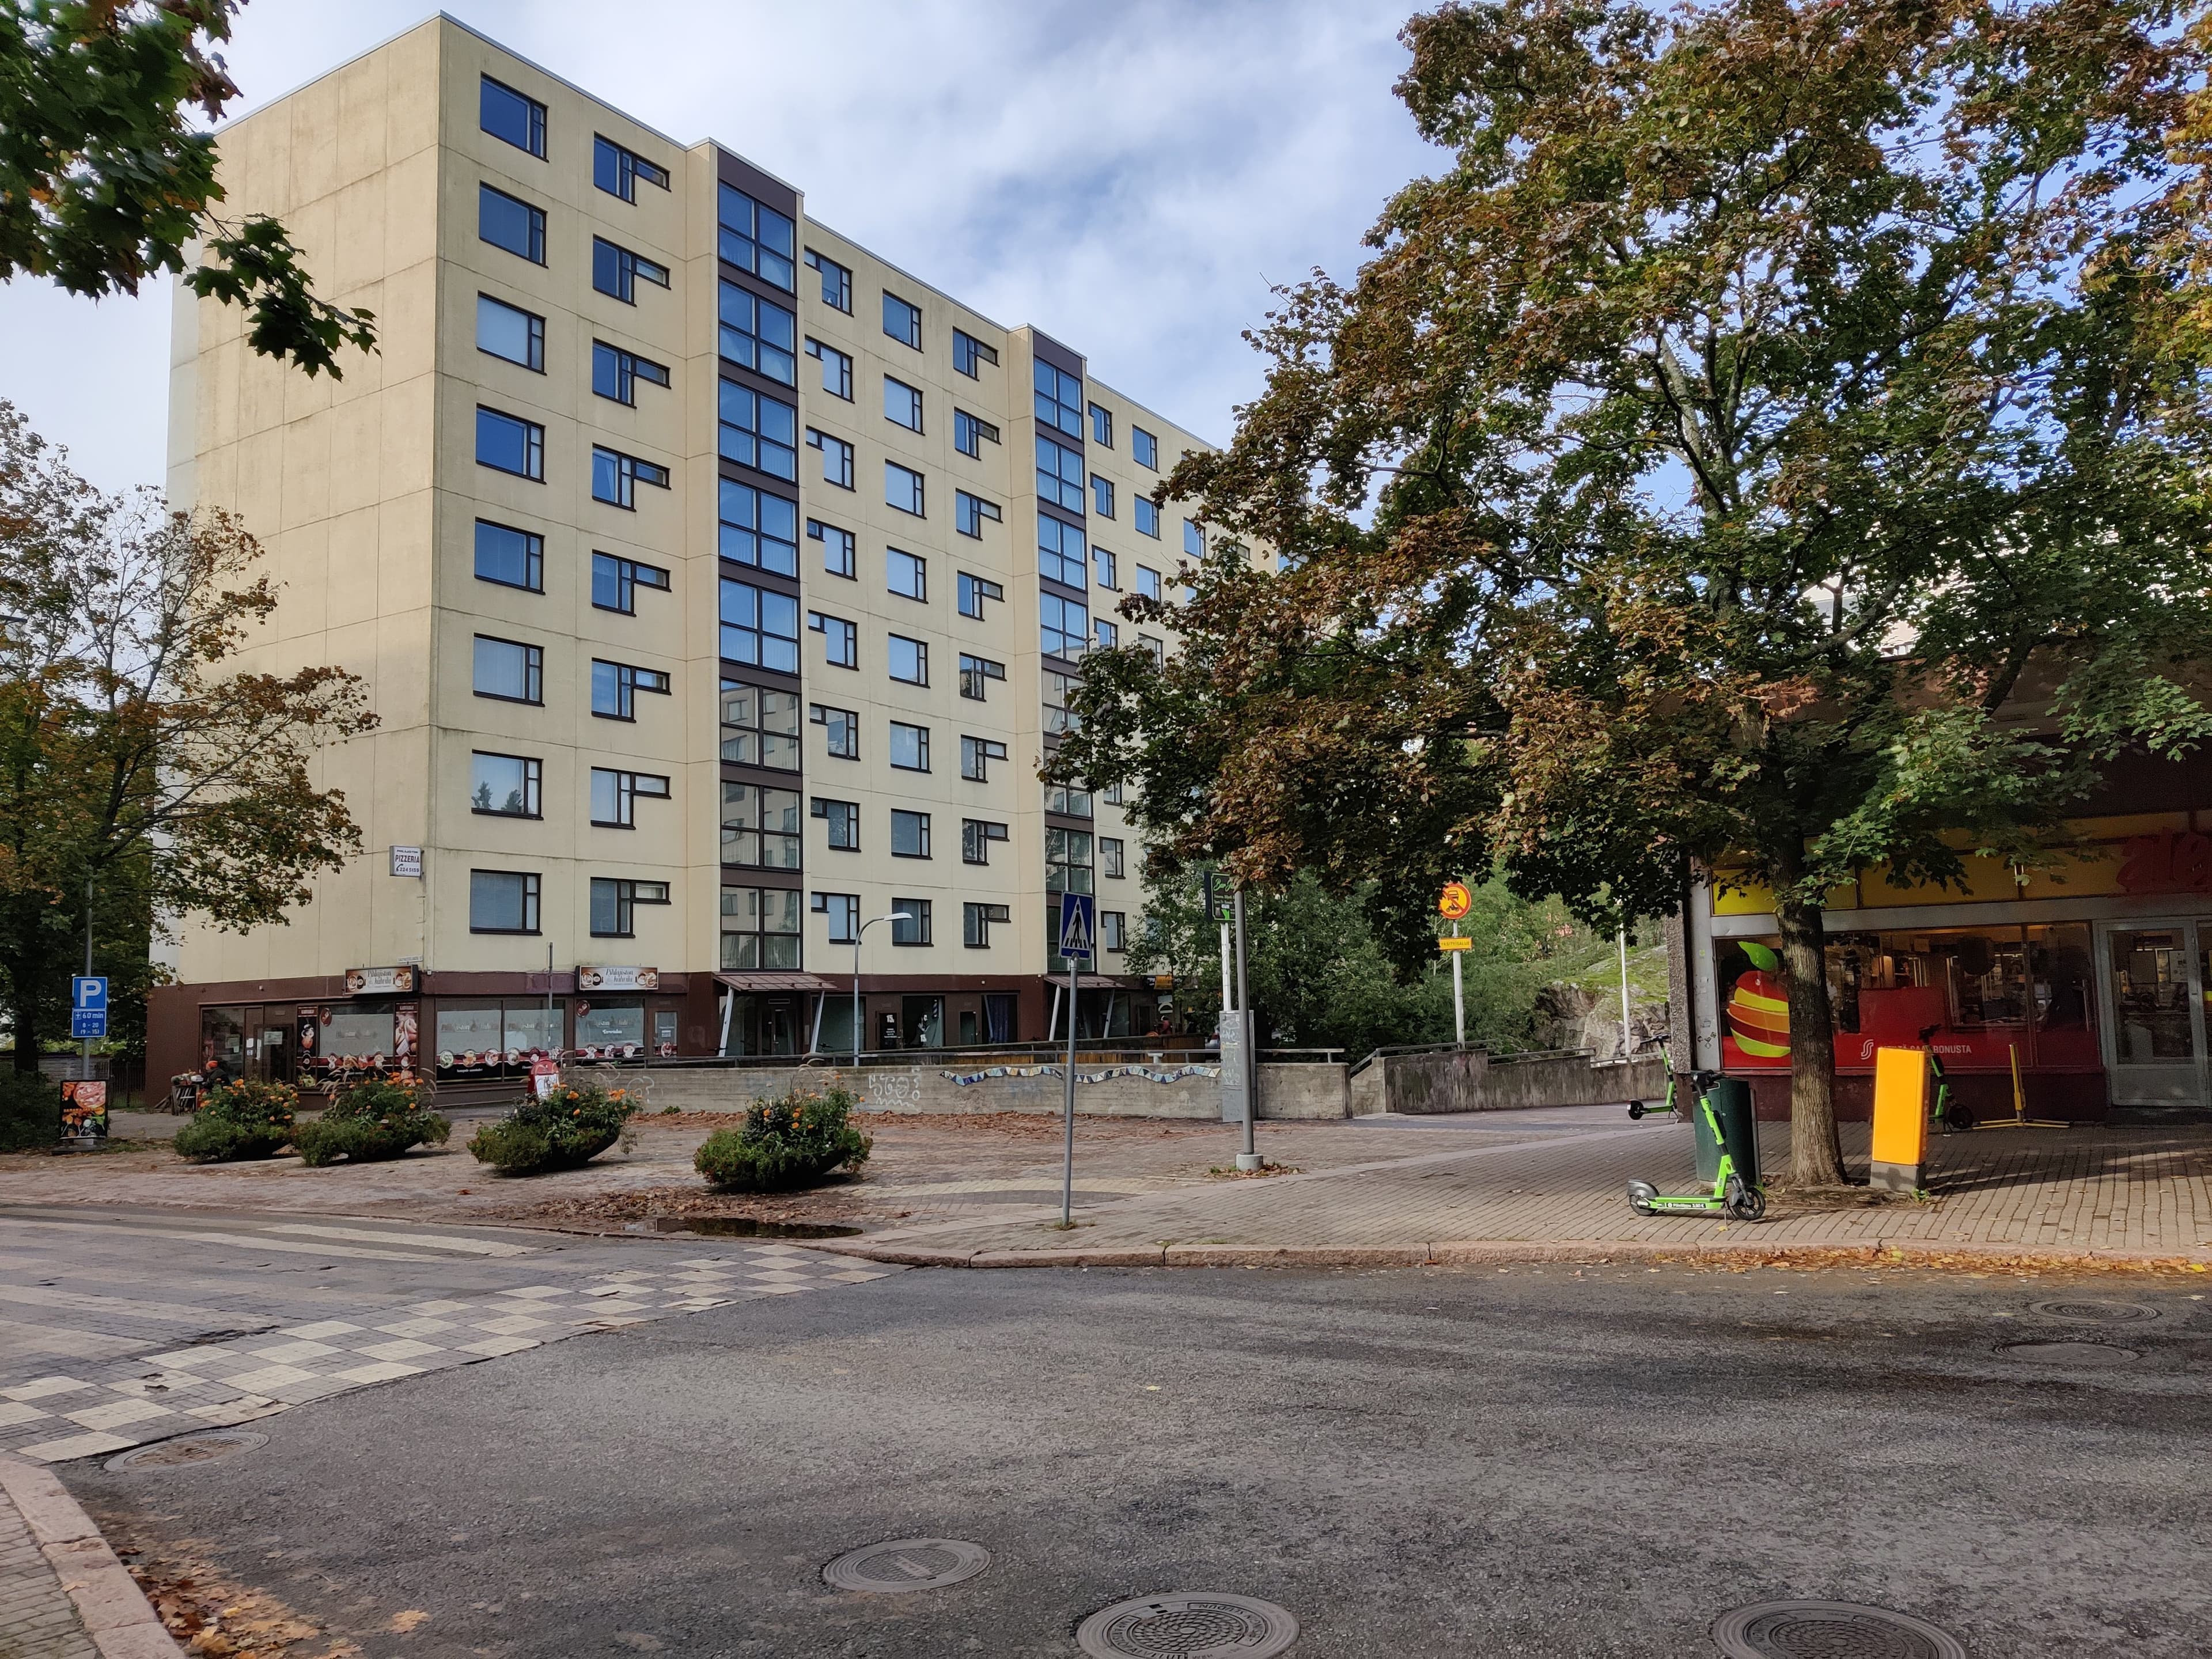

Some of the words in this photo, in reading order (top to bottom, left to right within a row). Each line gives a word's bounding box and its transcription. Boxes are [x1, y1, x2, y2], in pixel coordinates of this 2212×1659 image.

[395, 855, 420, 863] PIZZERIA
[80, 980, 102, 1007] P
[1933, 1045, 1972, 1054] BONUSTA
